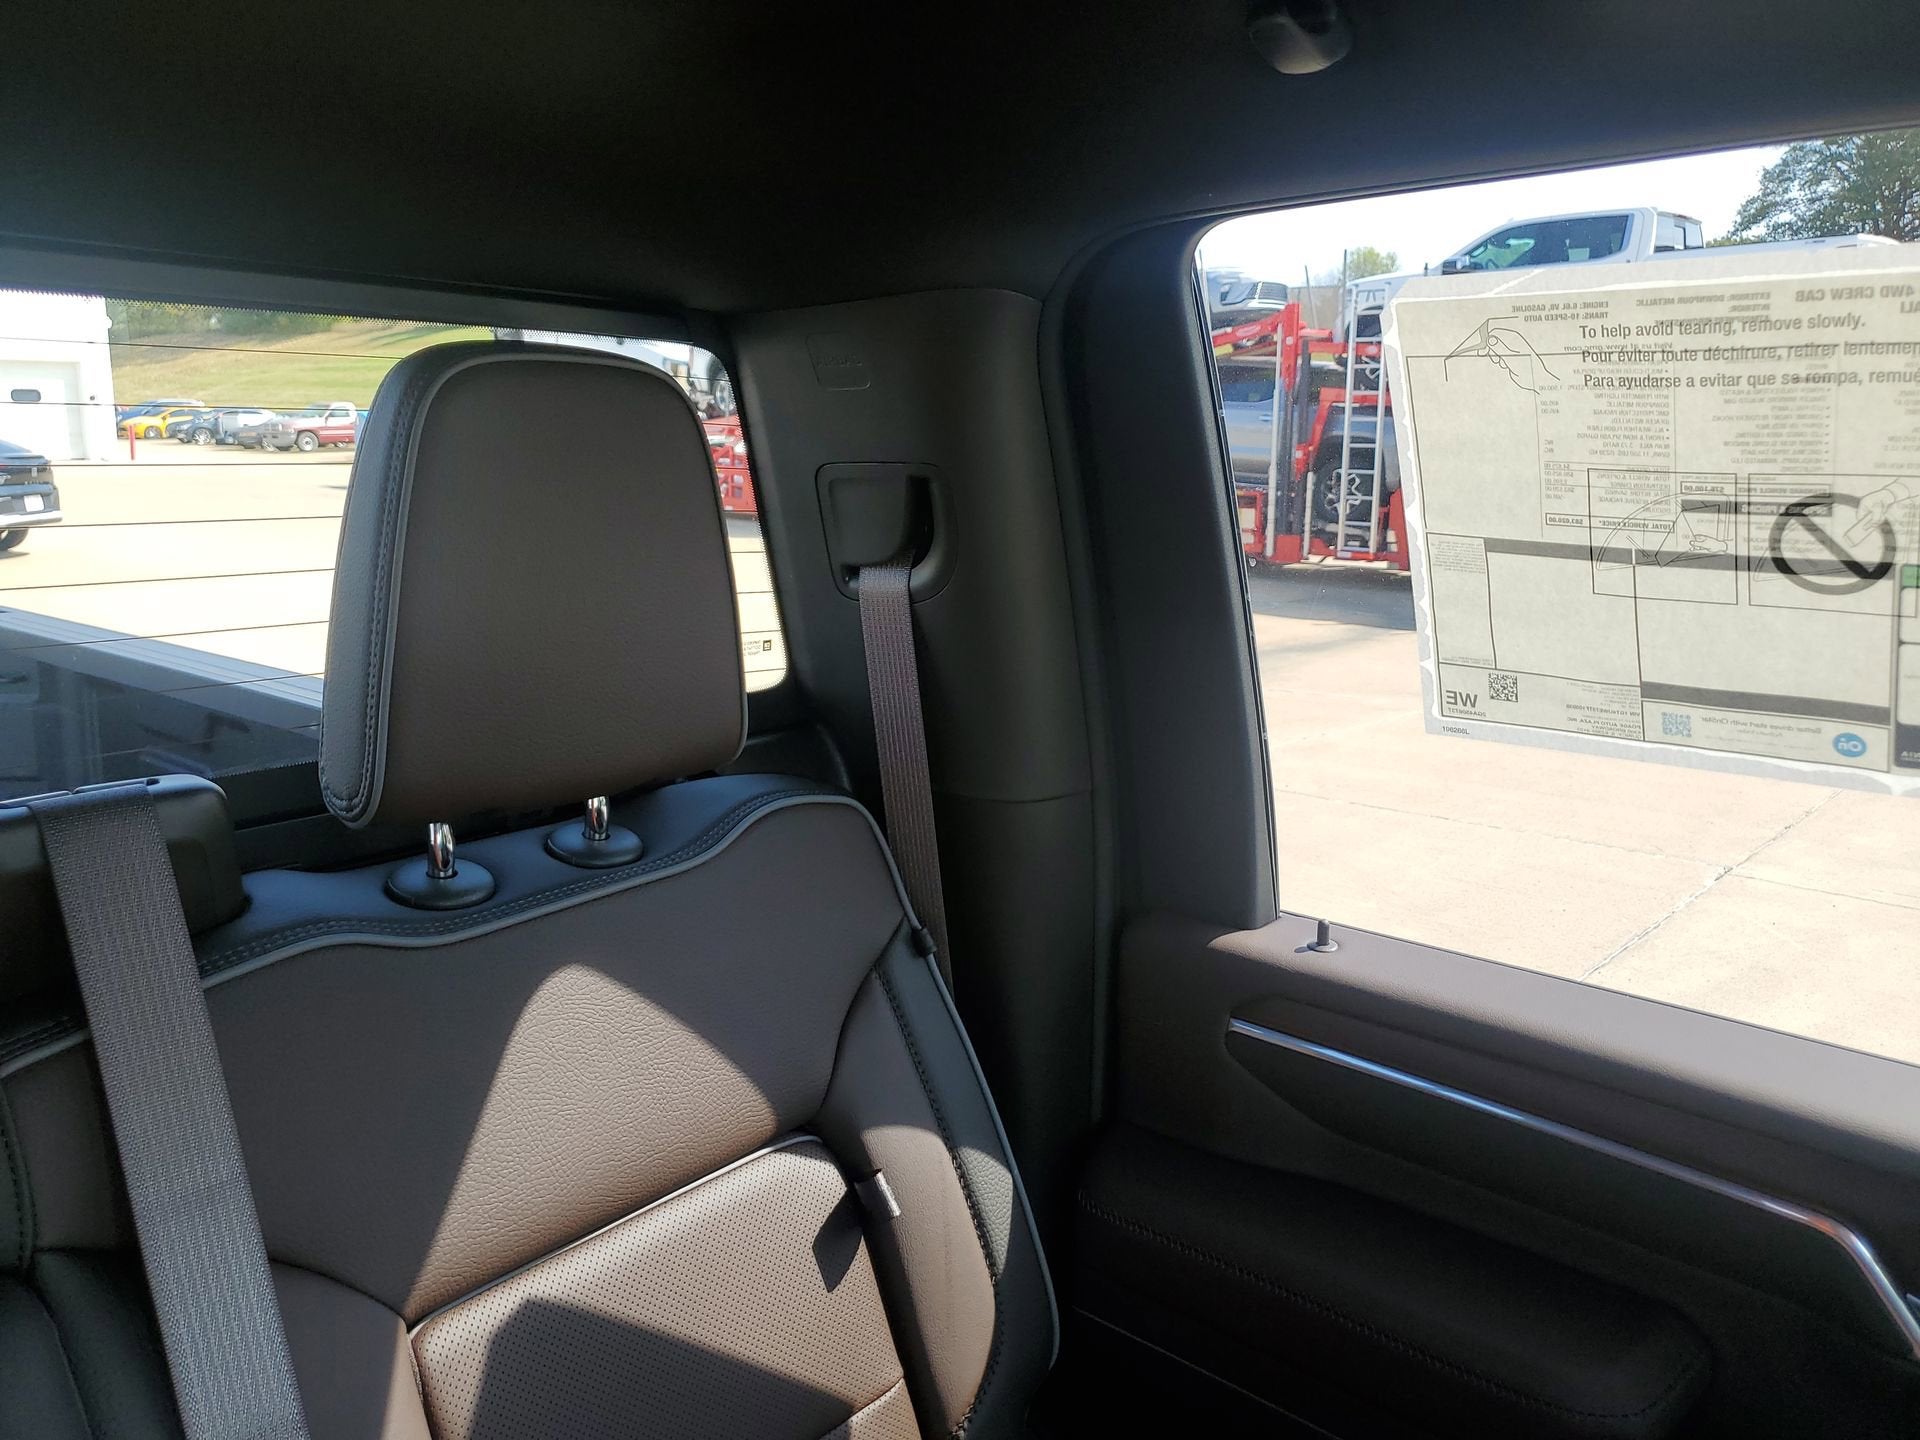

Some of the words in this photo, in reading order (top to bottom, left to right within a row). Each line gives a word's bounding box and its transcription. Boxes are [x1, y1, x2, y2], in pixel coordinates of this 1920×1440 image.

[1578, 325, 1597, 339] To
[1601, 323, 1631, 340] help
[1635, 321, 1674, 337] avoid
[1678, 319, 1737, 336] tearing,
[1741, 318, 1802, 332] remove
[1807, 312, 1866, 330] slowly.
[1581, 349, 1613, 363] Pour
[1617, 347, 1657, 362] éviter
[1661, 348, 1698, 362] toute
[1702, 345, 1782, 361] déchirure,
[1786, 343, 1838, 360] retirer
[1583, 374, 1615, 388] Para
[1618, 373, 1681, 390] ayudarse
[1686, 376, 1696, 388] a
[1699, 373, 1743, 388] evitar
[1747, 373, 1777, 388] que
[1781, 373, 1800, 386] se
[1804, 371, 1863, 387] rompa,
